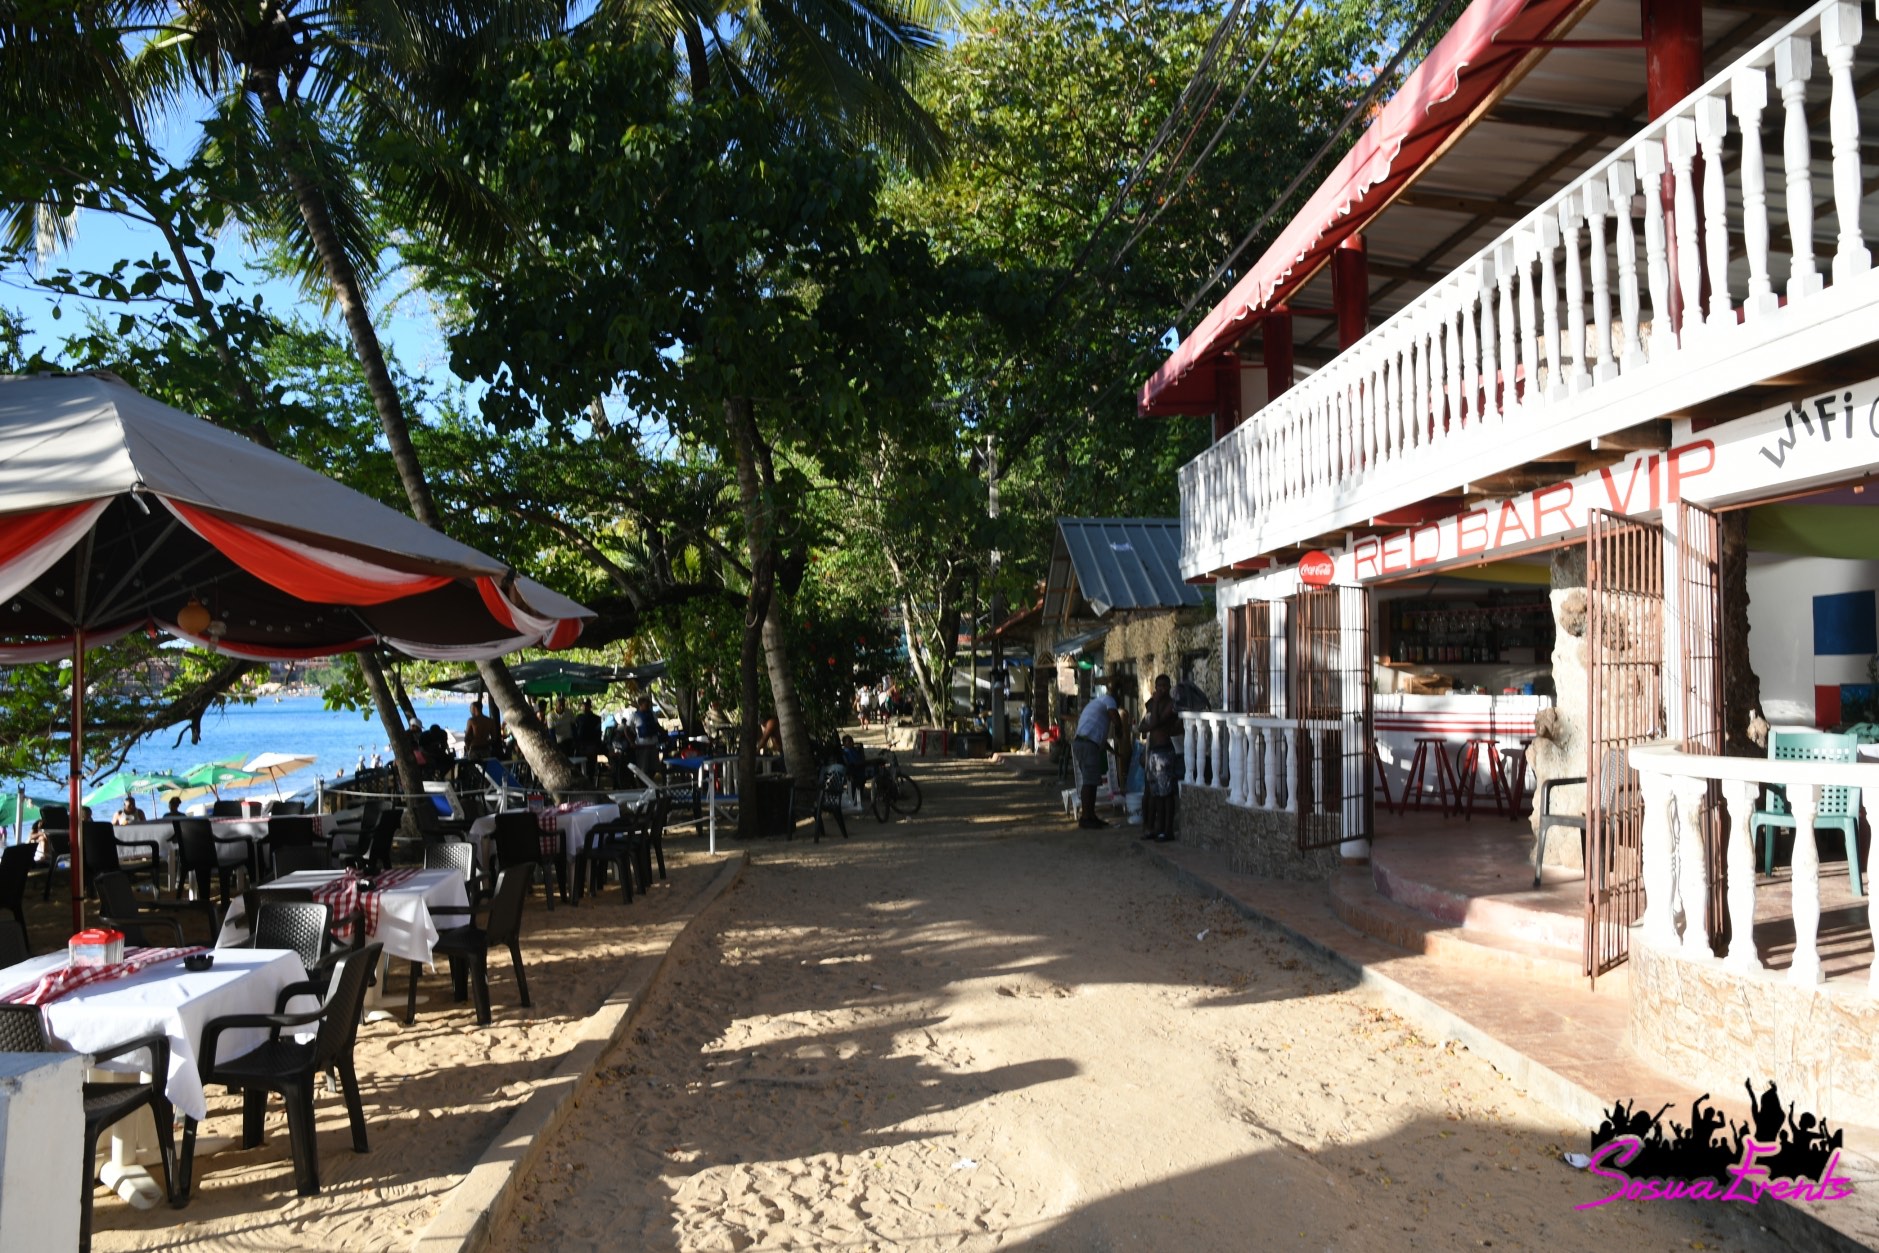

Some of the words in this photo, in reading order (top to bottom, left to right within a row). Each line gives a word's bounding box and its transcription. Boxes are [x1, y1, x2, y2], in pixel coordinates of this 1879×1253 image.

[1354, 521, 1440, 581] RED
[1457, 480, 1576, 557] BAR
[1600, 439, 1715, 516] VIP
